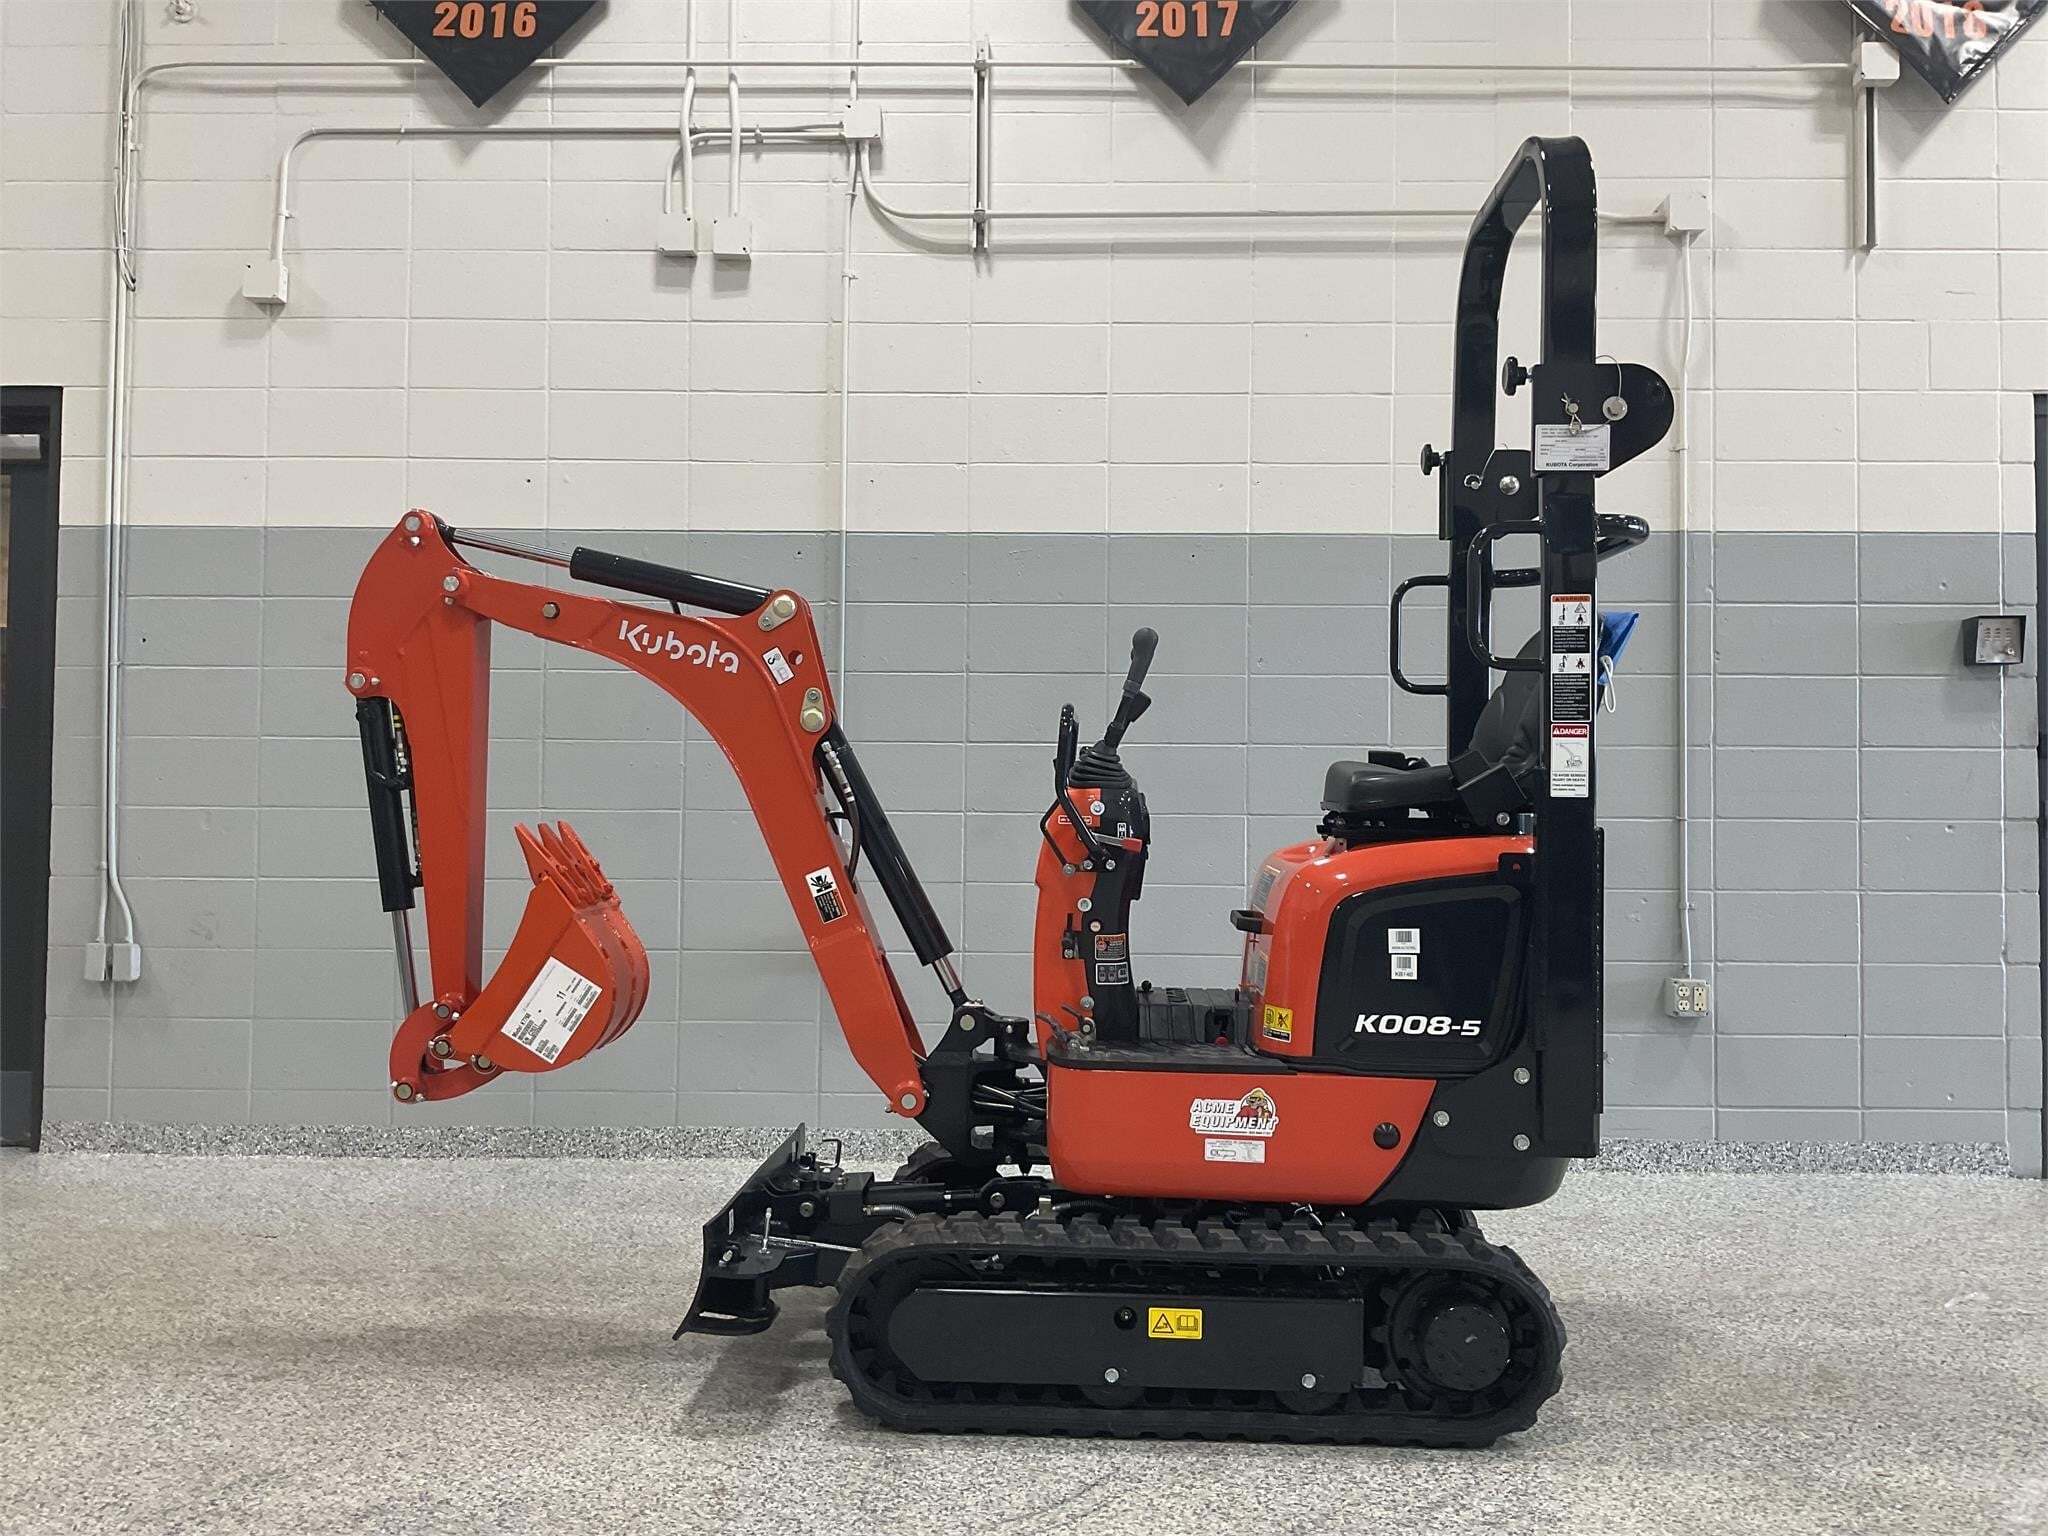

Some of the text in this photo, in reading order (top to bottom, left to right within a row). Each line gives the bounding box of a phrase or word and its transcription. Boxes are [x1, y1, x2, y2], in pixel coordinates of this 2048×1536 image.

[432, 1, 536, 39] 2016
[1136, 0, 1239, 38] 2017
[618, 620, 739, 674] Kubota
[1354, 1014, 1482, 1036] K008-5
[1192, 1114, 1277, 1130] EQUIPMENT
[1193, 1101, 1235, 1114] ACME
